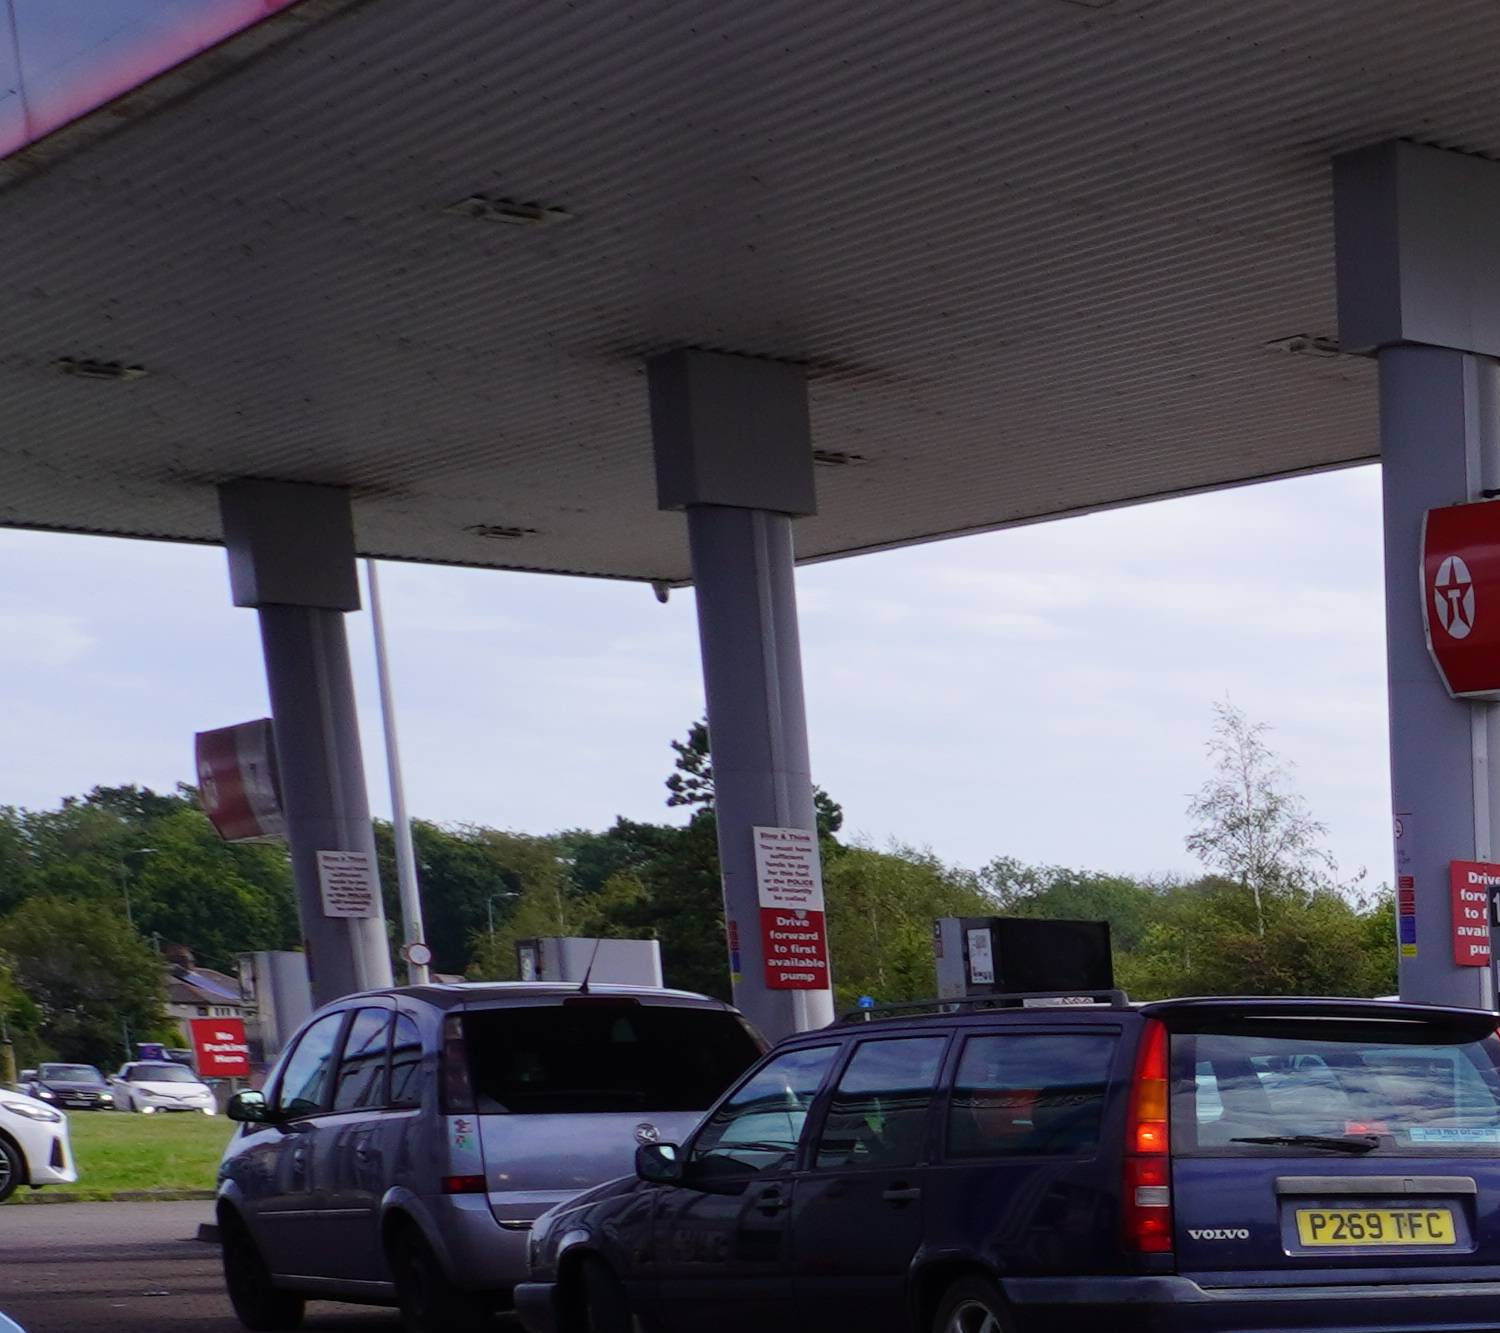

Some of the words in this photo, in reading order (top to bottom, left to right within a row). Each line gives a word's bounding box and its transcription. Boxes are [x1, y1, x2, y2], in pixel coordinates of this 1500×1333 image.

[1464, 907, 1479, 919] to
[776, 916, 810, 927] Drive
[769, 929, 819, 940] forward
[774, 944, 787, 953] to
[790, 944, 817, 954] first
[768, 958, 825, 968] available
[780, 972, 816, 982] pump
[214, 1031, 234, 1040] No
[1310, 1213, 1383, 1240] P269
[1391, 1212, 1444, 1239] TFC
[1188, 1229, 1249, 1240] VOLVO
